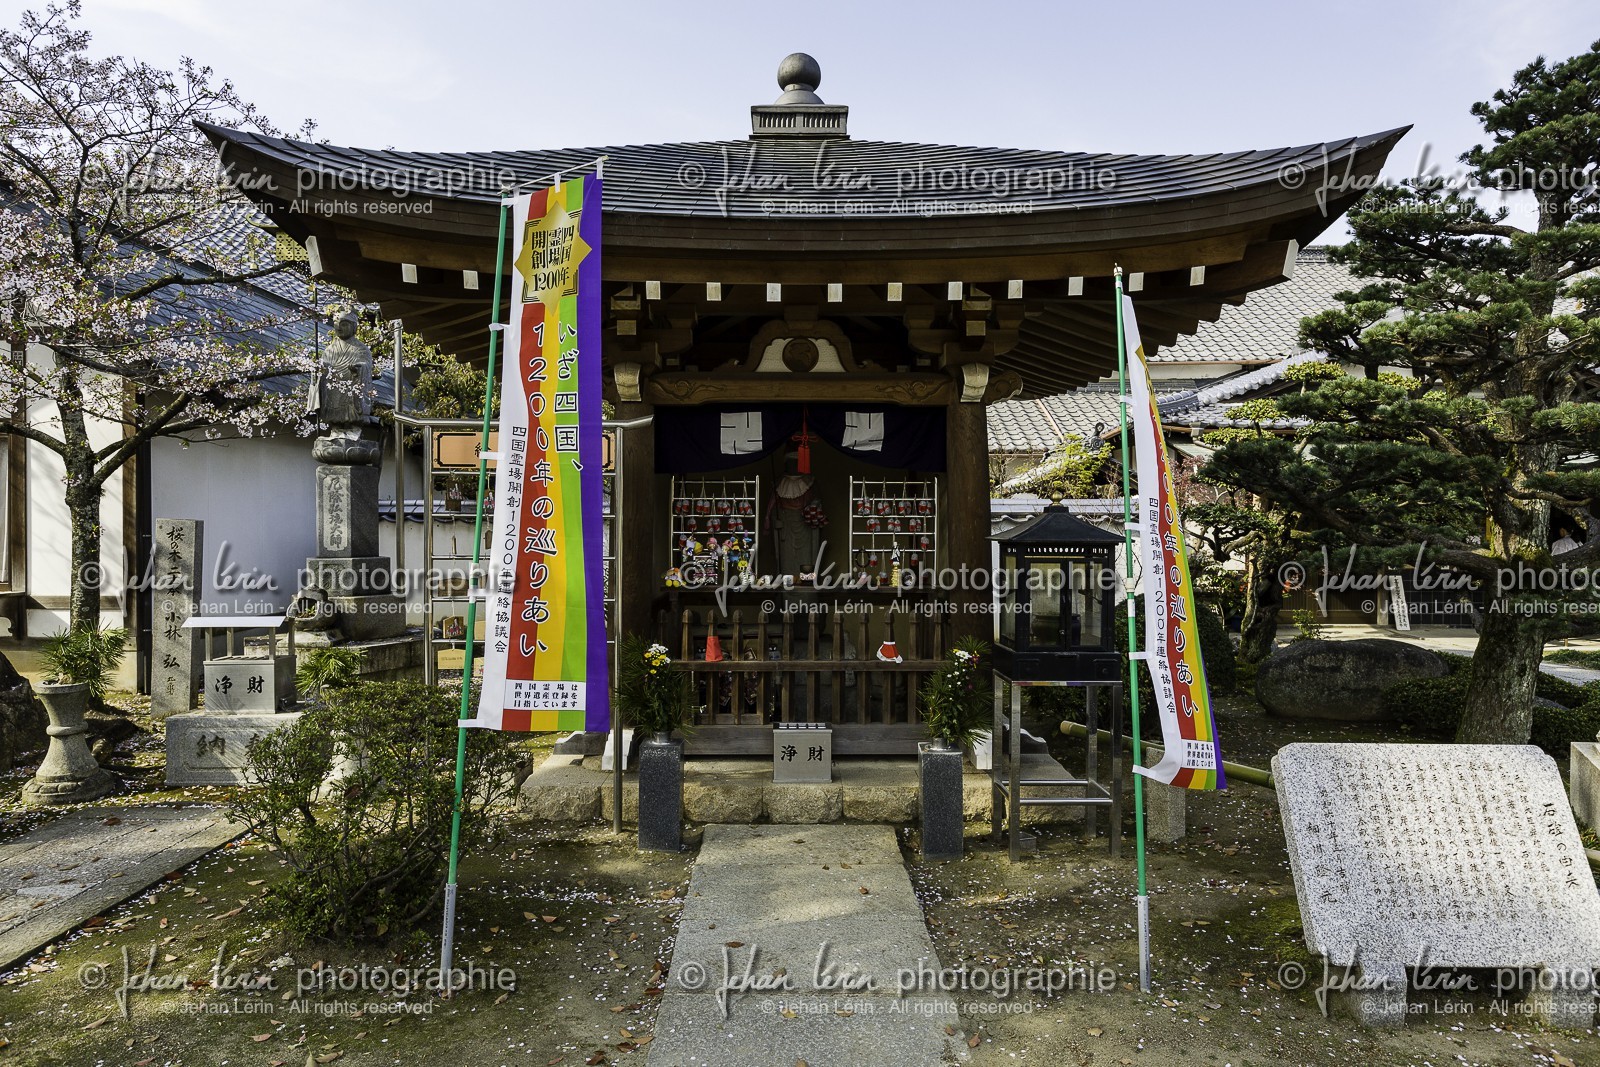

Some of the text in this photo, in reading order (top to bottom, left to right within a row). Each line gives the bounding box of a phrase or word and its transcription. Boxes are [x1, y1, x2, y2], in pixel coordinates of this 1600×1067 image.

[531, 230, 546, 269] 開創
[548, 227, 562, 266] 霊場
[560, 225, 575, 264] 四国
[532, 266, 570, 292] 1200年
[520, 322, 558, 656] 1200年の巡りあい
[214, 675, 265, 694] 浄財
[514, 683, 578, 691] 四国霊場は
[514, 691, 578, 700] 世界遺産登録を
[514, 700, 578, 708] 目指しています
[780, 745, 825, 762] 浄財
